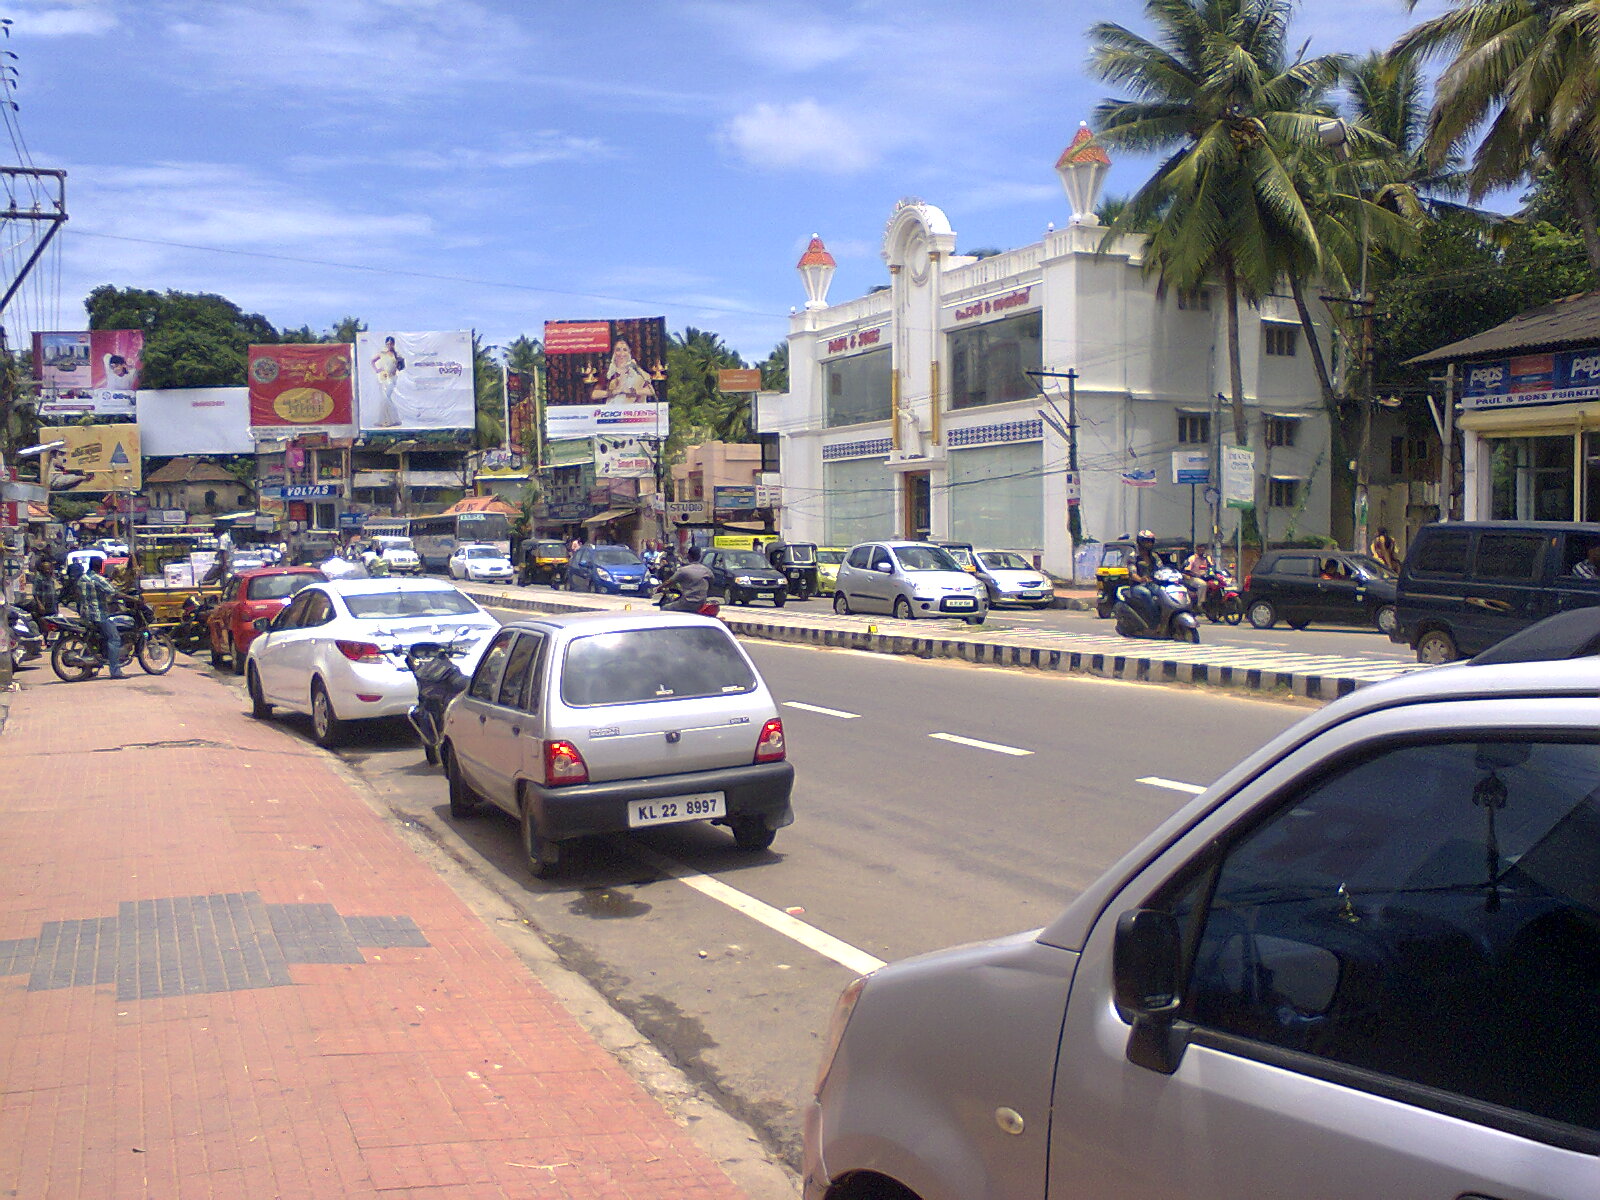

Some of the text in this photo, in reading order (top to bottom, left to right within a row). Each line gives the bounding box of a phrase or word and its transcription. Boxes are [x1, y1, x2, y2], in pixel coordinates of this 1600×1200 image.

[1475, 397, 1503, 405] PAUL
[1518, 393, 1548, 401] SONS
[286, 484, 329, 496] VOLTAS
[670, 503, 704, 512] STUDIO
[686, 799, 717, 815] 8997
